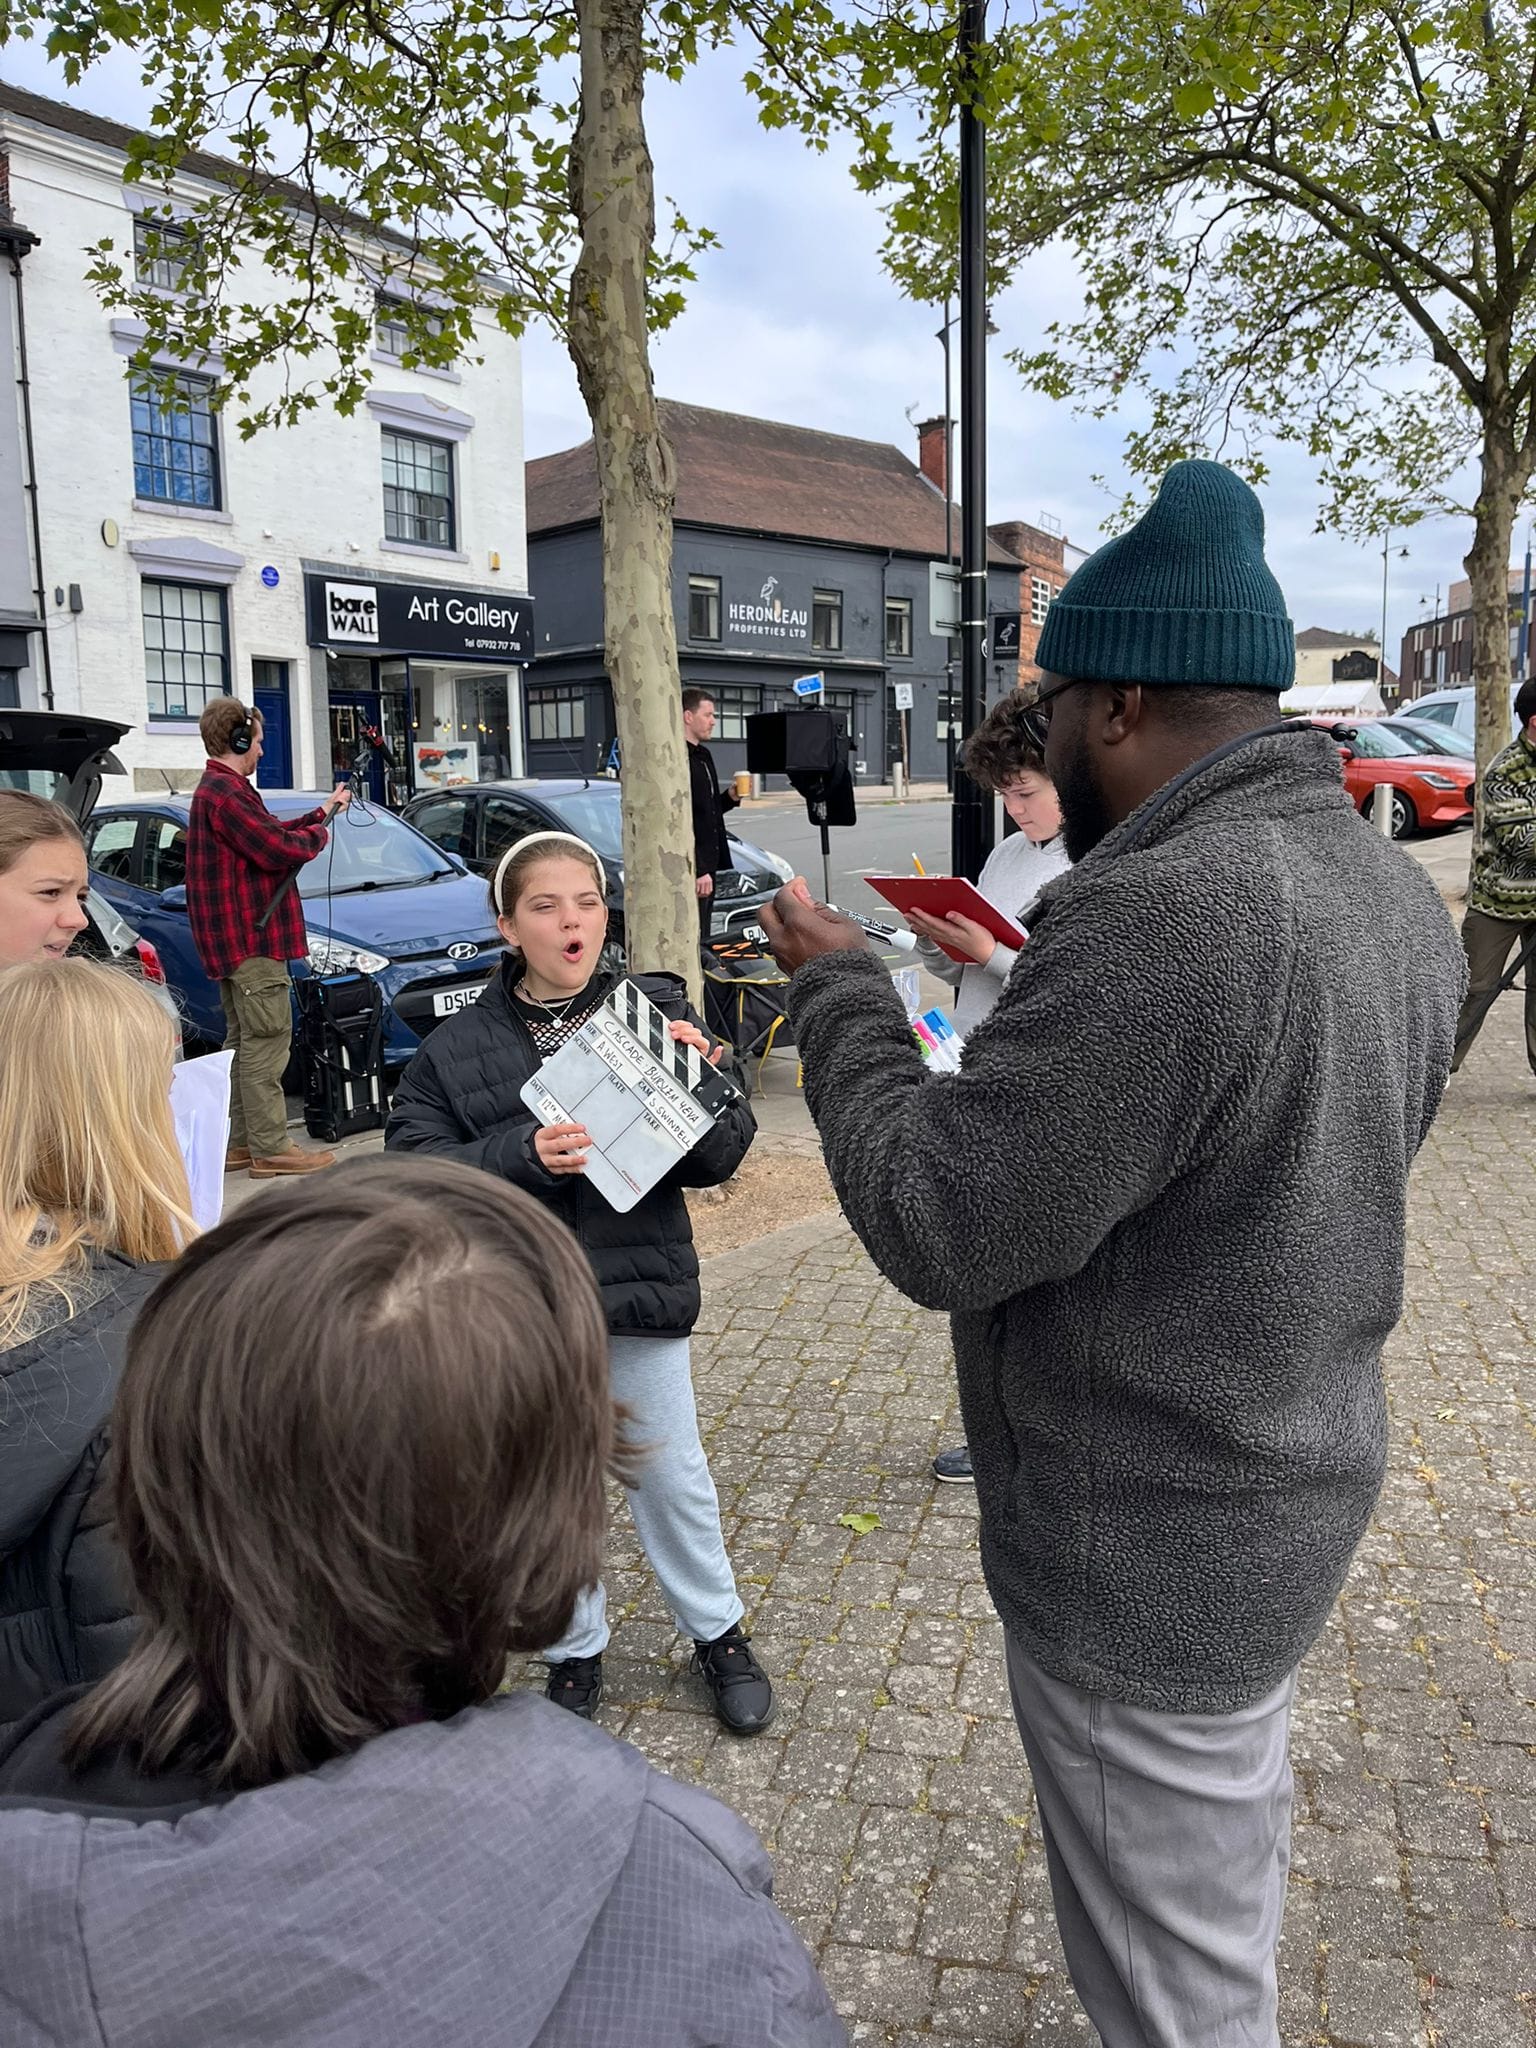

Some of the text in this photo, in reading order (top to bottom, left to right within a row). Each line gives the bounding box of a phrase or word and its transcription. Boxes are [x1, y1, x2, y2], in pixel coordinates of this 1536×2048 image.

[330, 592, 376, 614] bare
[331, 614, 378, 633] WALL
[408, 596, 519, 634] Art Gallery
[729, 623, 807, 638] PROPERTIES LTD
[464, 638, 475, 648] Tel
[573, 1035, 592, 1055] SCENE
[530, 1079, 546, 1095] DATE
[608, 1073, 627, 1094] SLATE
[643, 1112, 661, 1132] TAKE
